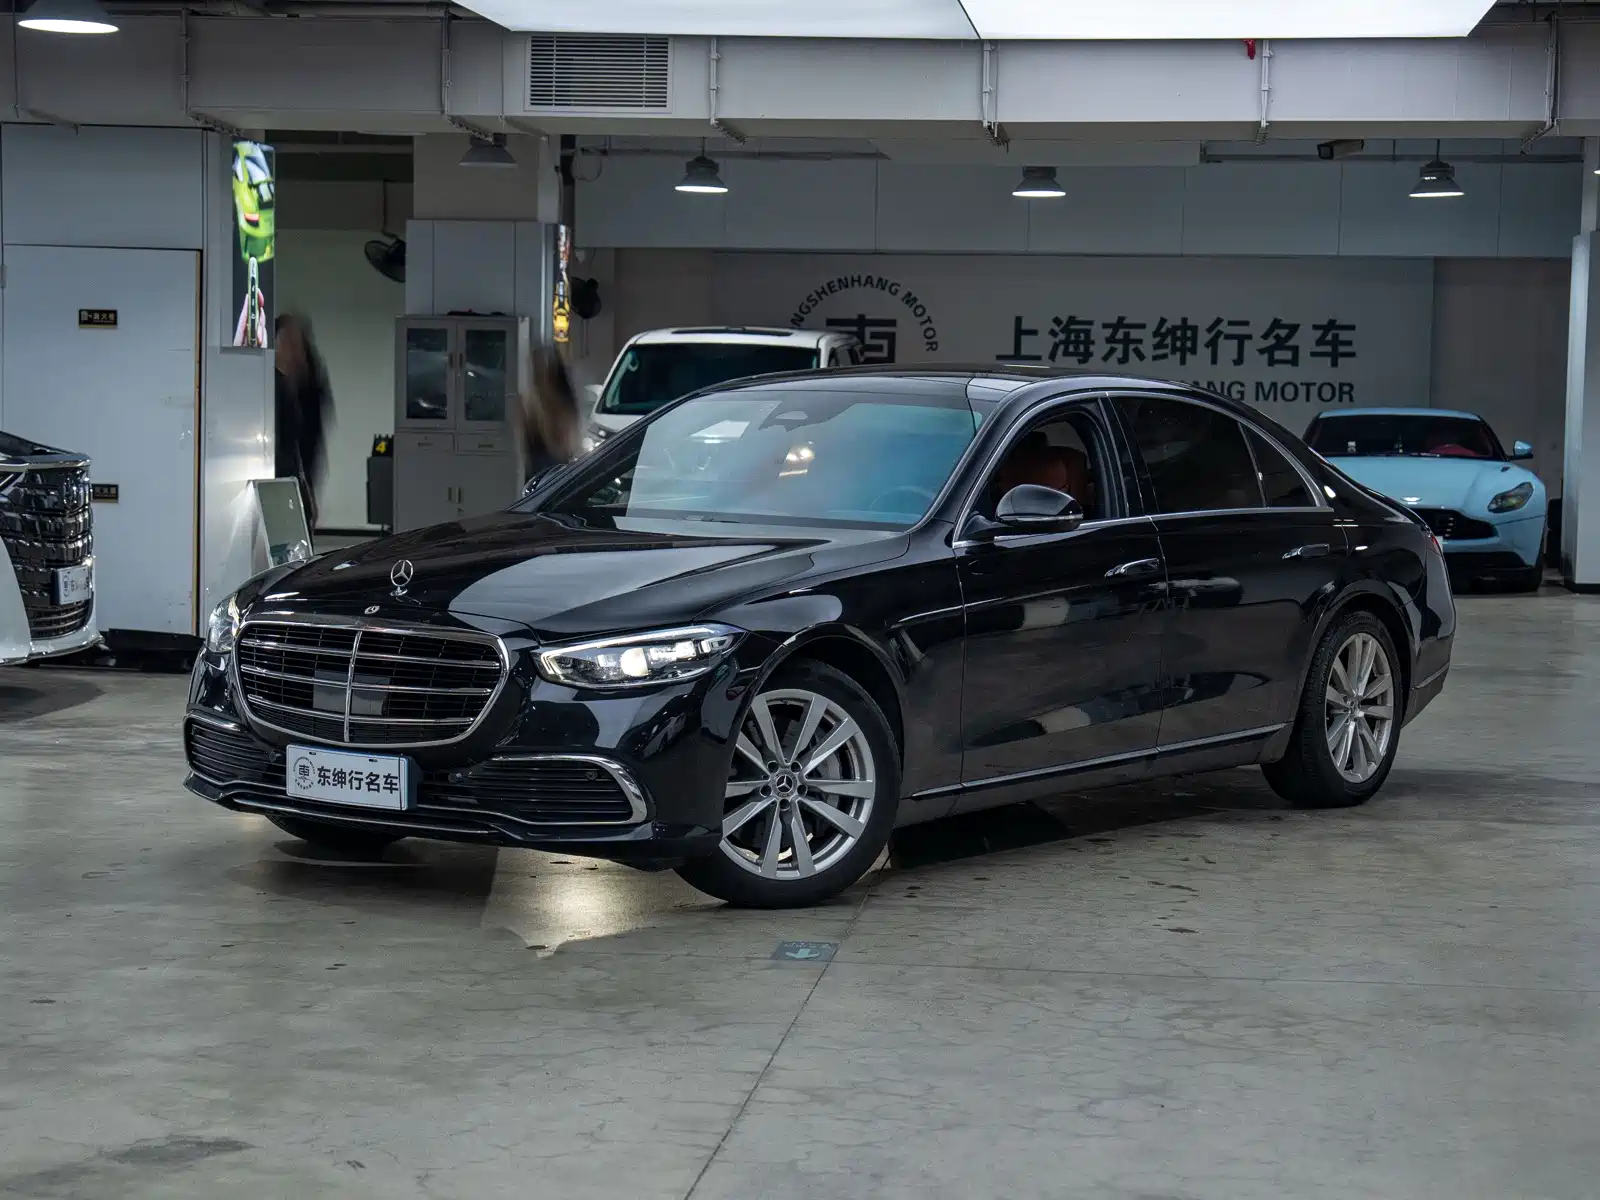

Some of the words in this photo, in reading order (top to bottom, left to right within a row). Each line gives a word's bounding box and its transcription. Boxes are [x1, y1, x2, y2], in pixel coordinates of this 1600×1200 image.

[900, 290, 939, 352] MOTOR
[995, 315, 1357, 368] 上海东绅行名车
[1254, 380, 1355, 403] MOTOR
[316, 765, 399, 794] 东绅行名车
